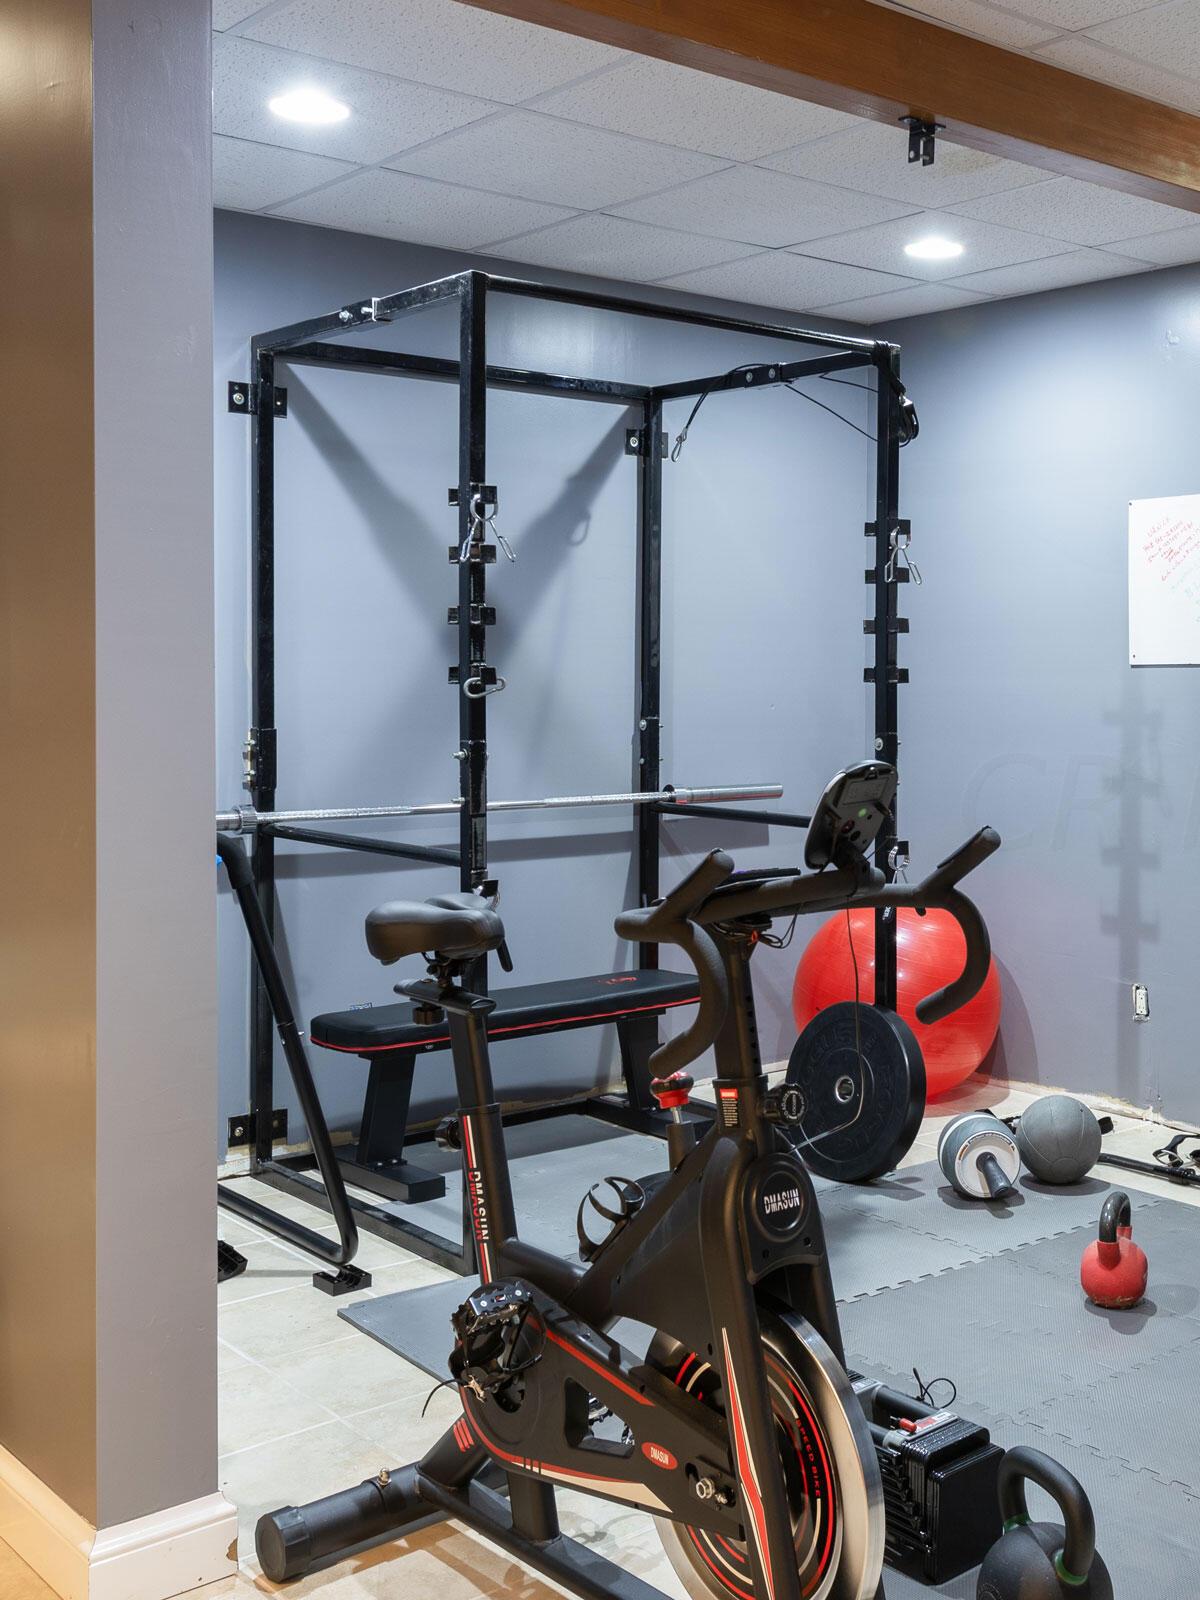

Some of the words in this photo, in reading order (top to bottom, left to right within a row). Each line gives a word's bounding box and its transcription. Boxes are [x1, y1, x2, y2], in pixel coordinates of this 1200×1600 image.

[468, 1171, 489, 1240] DMASUN
[763, 1188, 800, 1214] DMASUN
[650, 1446, 669, 1465] DMASUN
[795, 1419, 815, 1462] SPEED
